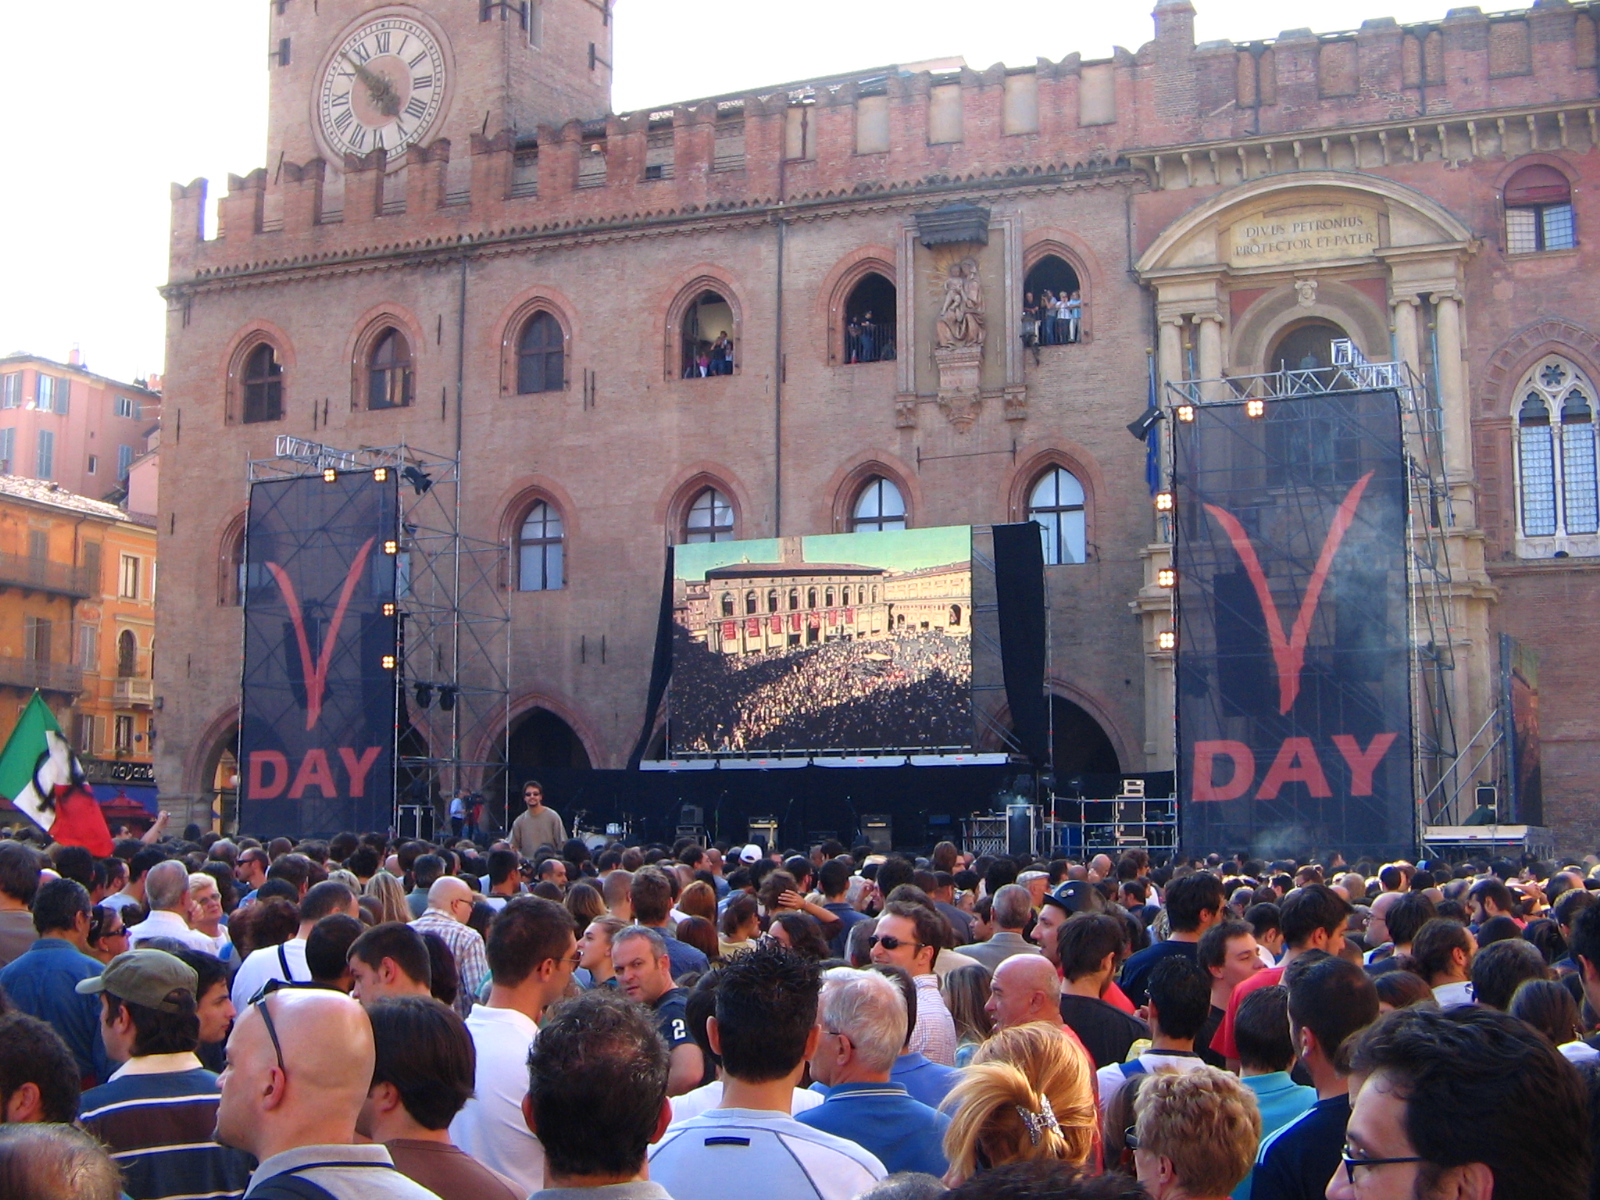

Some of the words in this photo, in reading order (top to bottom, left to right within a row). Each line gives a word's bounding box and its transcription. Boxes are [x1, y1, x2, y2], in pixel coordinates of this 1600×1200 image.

[1235, 238, 1312, 257] PROTECTOR
[1317, 236, 1331, 248] ET
[1334, 232, 1375, 246] PATER
[1292, 216, 1364, 233] PETRONIUS
[1202, 469, 1376, 716] V
[264, 534, 377, 732] V
[247, 746, 383, 800] DAY
[1191, 731, 1399, 803] DAY
[671, 1018, 687, 1040] 2
